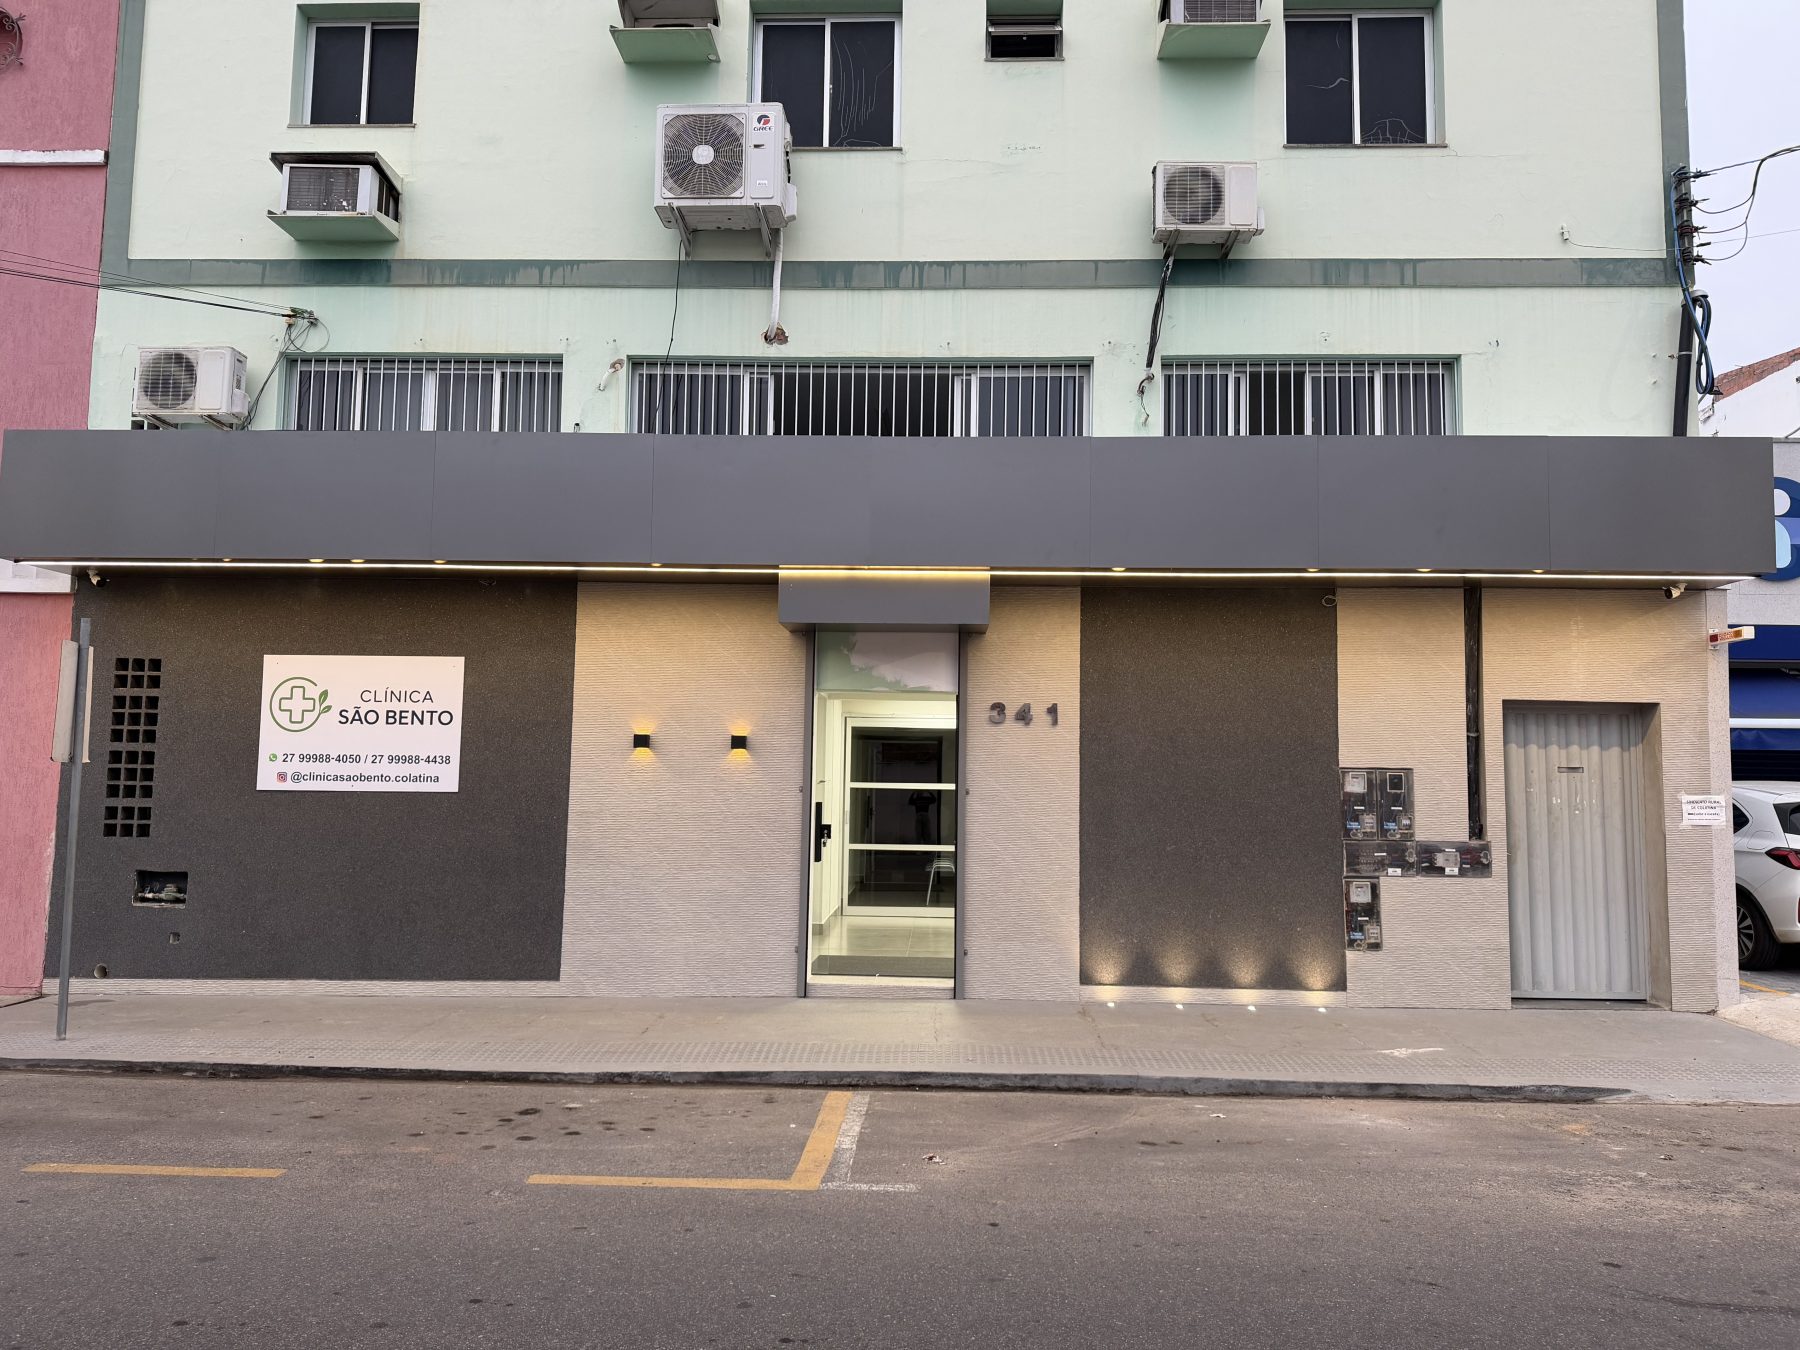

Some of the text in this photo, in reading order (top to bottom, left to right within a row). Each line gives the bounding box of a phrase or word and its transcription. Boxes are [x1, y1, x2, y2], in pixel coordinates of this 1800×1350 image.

[360, 686, 434, 704] CLÍNICA
[338, 706, 454, 726] SÃO BENTO
[989, 701, 1059, 727] 341
[282, 753, 296, 764] 27
[298, 753, 361, 764] 99988-4050
[371, 754, 384, 764] 27
[387, 755, 451, 765] 99988-4438
[290, 771, 440, 784] @clinicasaobento.colatina
